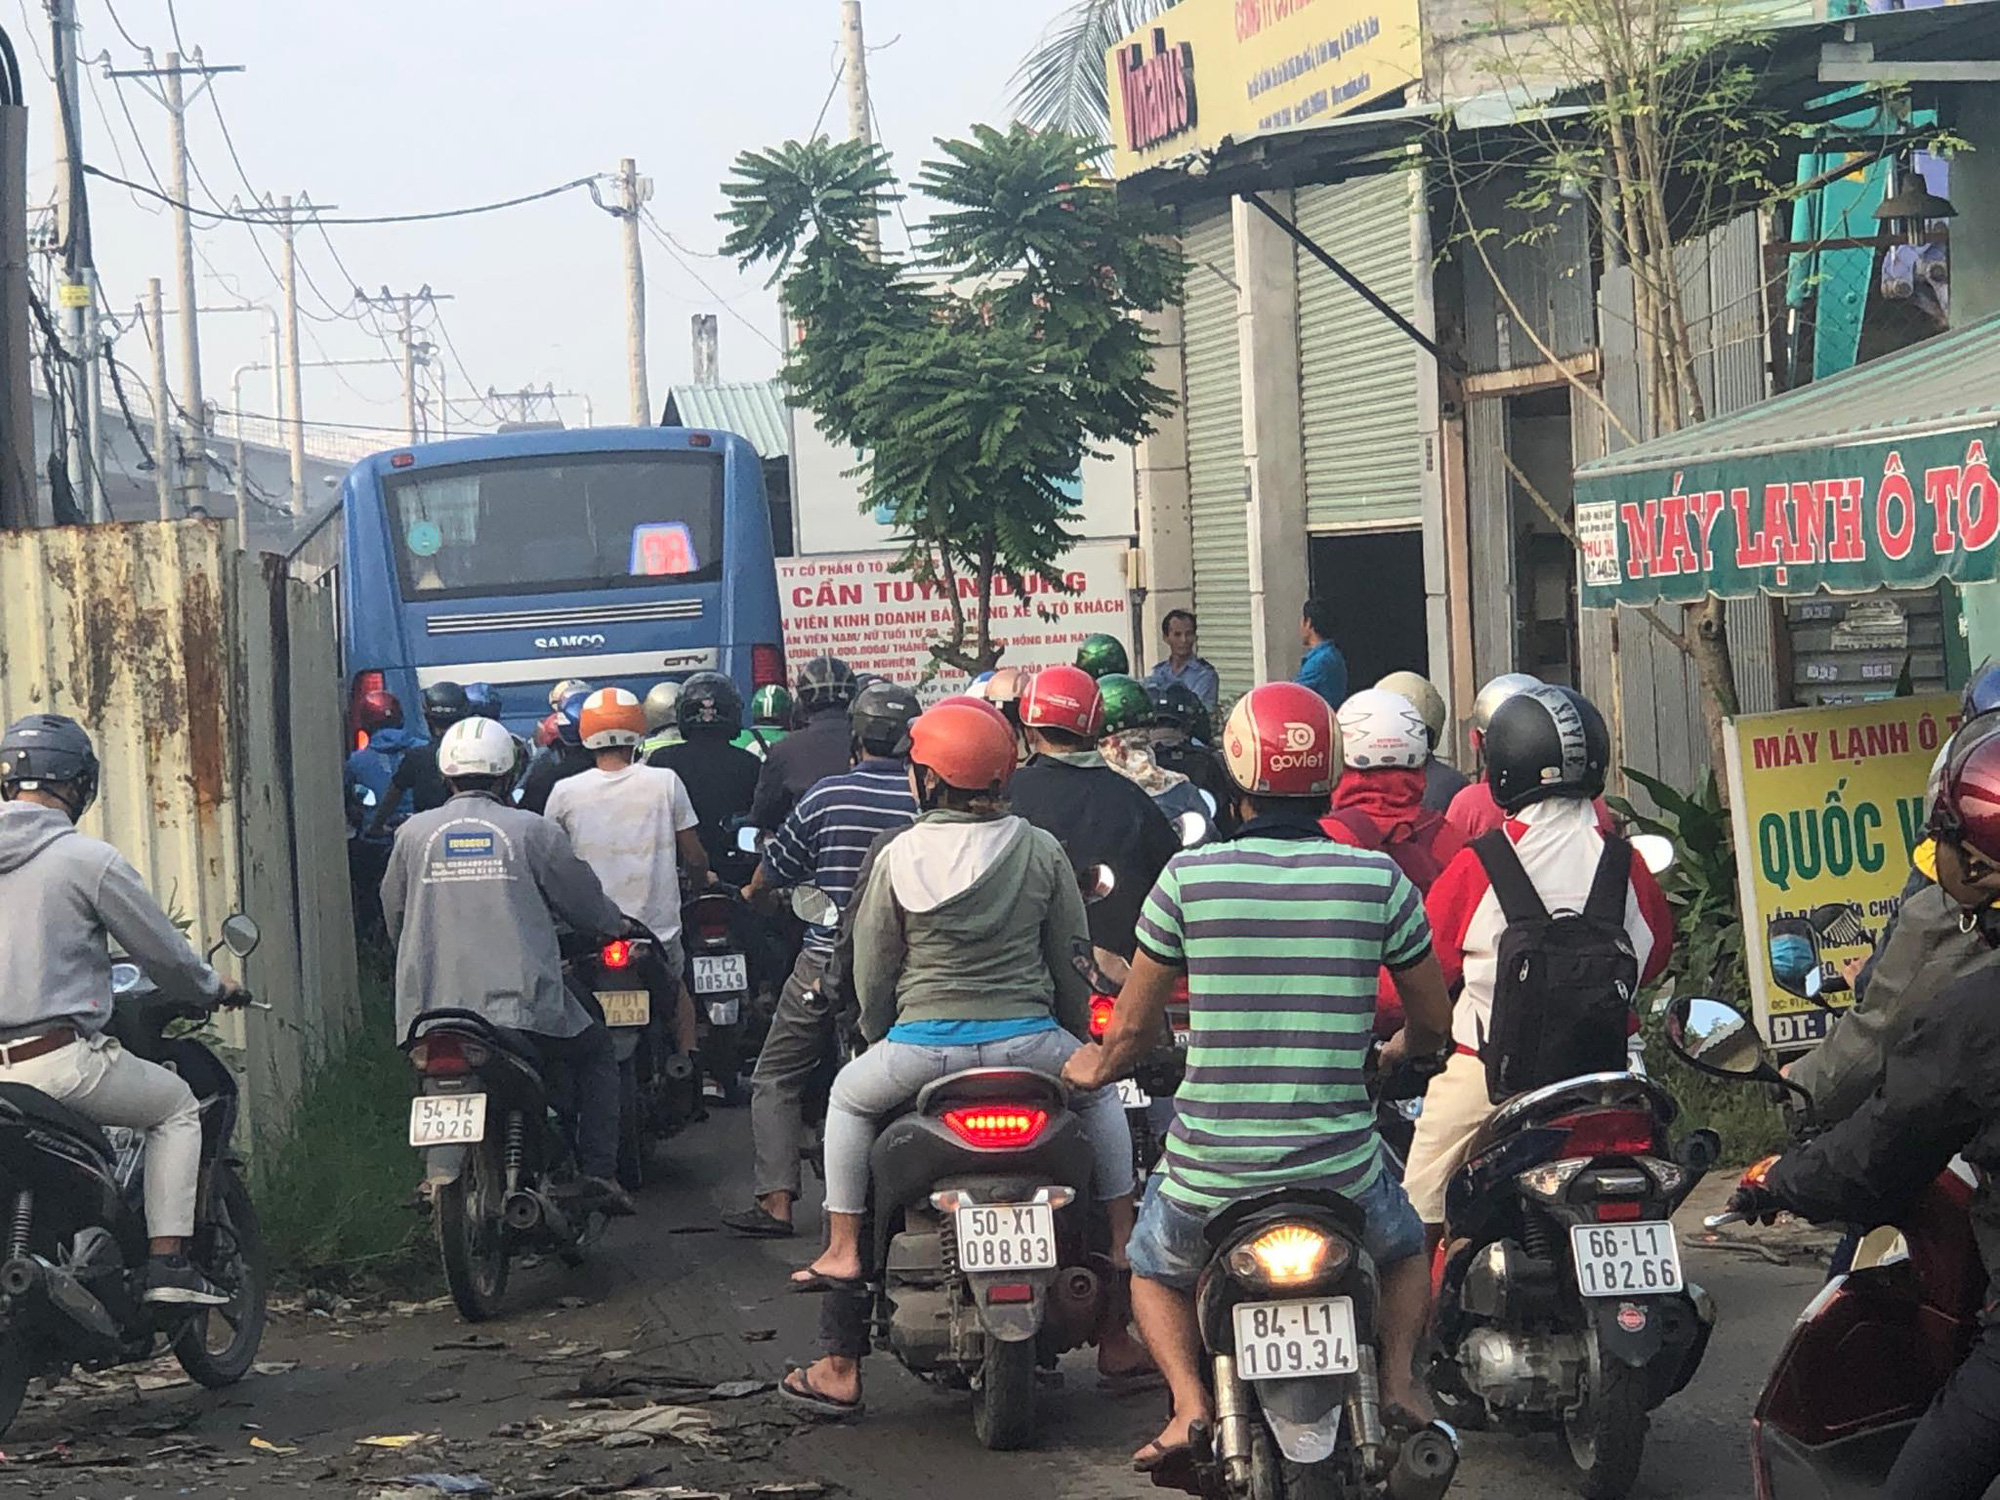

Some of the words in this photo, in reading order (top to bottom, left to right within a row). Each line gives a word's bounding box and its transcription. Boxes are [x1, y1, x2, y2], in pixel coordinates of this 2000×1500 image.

[1621, 471, 1724, 580] MÁY
[1730, 476, 1866, 587] LẠNH
[1876, 451, 1916, 561] Ô
[1924, 439, 2000, 556] TÔ
[781, 567, 795, 578] TY
[833, 613, 870, 628] KINH
[874, 610, 927, 626] DOANH
[967, 604, 1009, 622] HNG
[1013, 605, 1032, 619] XE
[1073, 598, 1125, 615] KHÁCH
[1753, 728, 1820, 771] MÁY
[1830, 720, 1910, 767] LẠNH
[1917, 711, 1940, 752] Ô
[1758, 778, 1886, 892] QUỐC
[1772, 1014, 1817, 1042] ĐT:
[422, 1098, 474, 1121] 54-T4
[422, 1120, 474, 1142] 7926
[972, 1208, 1037, 1237] 50-X1
[966, 1237, 1050, 1267] 088.83
[1588, 1226, 1659, 1259] 66-L1
[1584, 1258, 1676, 1291] 182.66
[1252, 1303, 1334, 1339] 84-L1
[1244, 1337, 1350, 1374] 109.34
